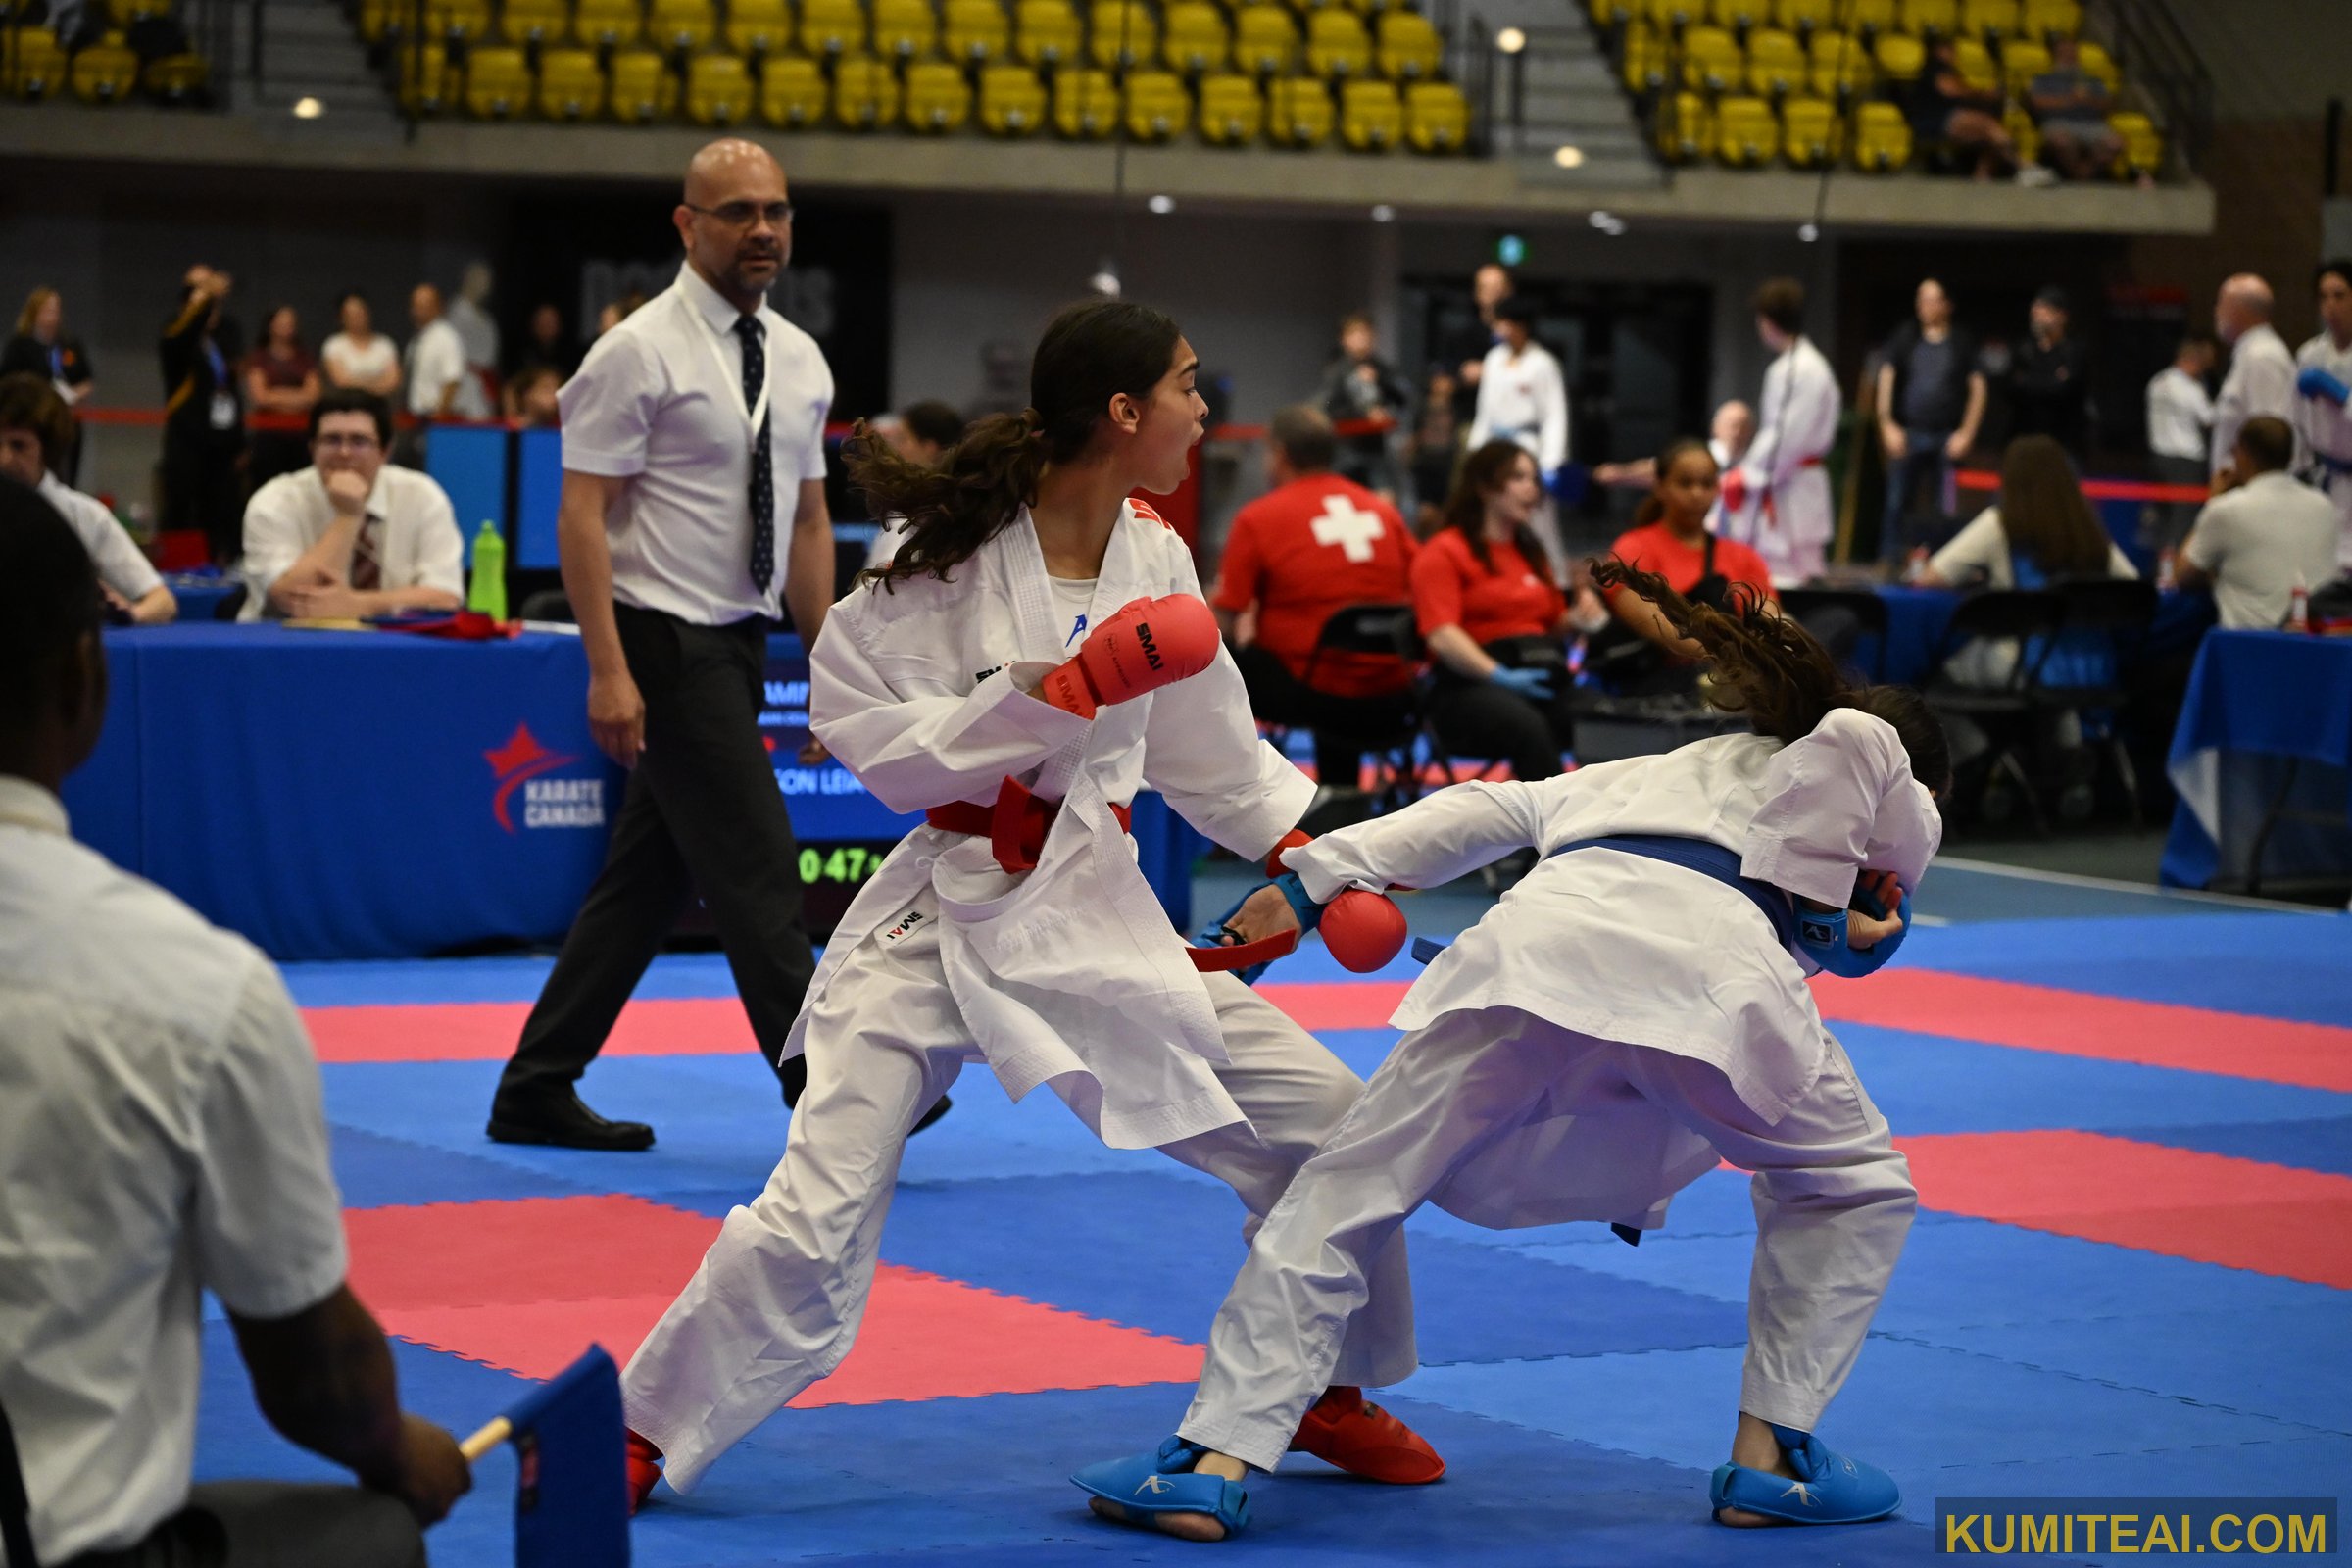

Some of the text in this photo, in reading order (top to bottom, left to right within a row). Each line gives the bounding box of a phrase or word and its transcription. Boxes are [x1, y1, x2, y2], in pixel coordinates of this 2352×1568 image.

[1136, 622, 1164, 671] SMAI
[525, 779, 605, 803] KARATE
[525, 803, 606, 828] CANADA
[886, 911, 923, 940] SMAI
